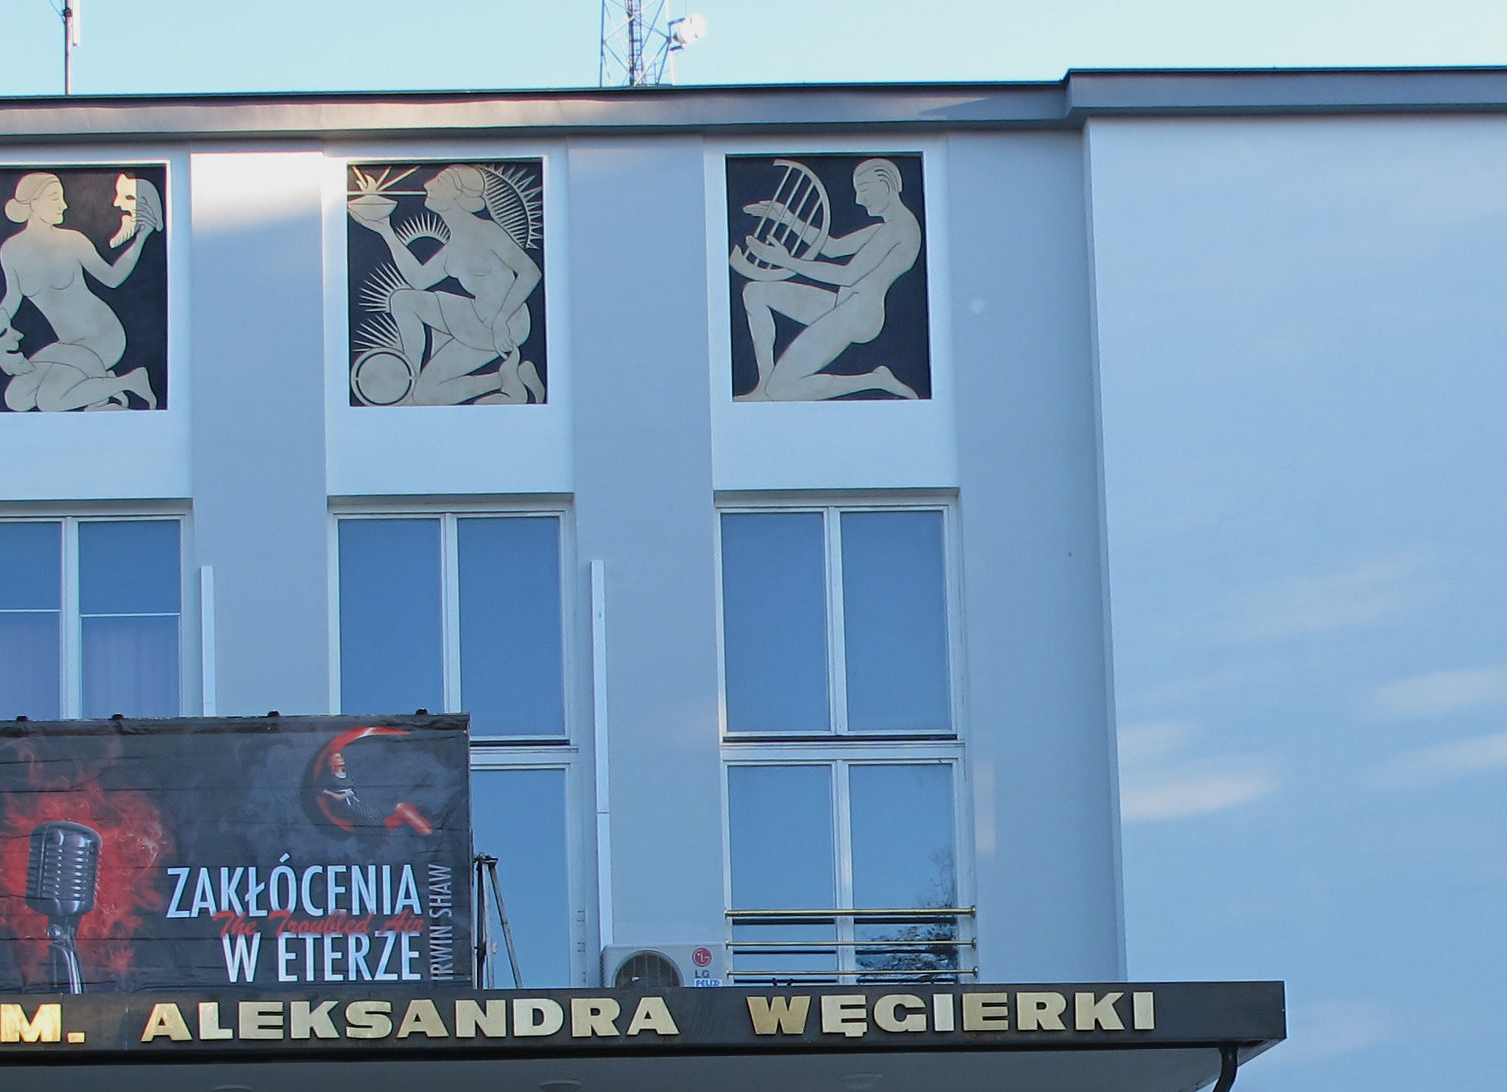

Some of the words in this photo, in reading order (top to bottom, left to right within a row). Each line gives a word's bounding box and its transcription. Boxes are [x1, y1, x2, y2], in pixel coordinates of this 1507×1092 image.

[166, 853, 422, 918] ZAKŁÓCENIA
[428, 864, 452, 918] SHAW
[212, 910, 257, 936] The
[268, 910, 374, 936] Troubled
[380, 909, 424, 934] Air
[221, 931, 262, 983] W
[278, 930, 422, 982] ETERZE
[429, 925, 453, 980] IRWIN
[695, 969, 710, 978] LG
[140, 997, 681, 1043] ALEKSANDRA
[746, 991, 1155, 1037] WĘGIERKI
